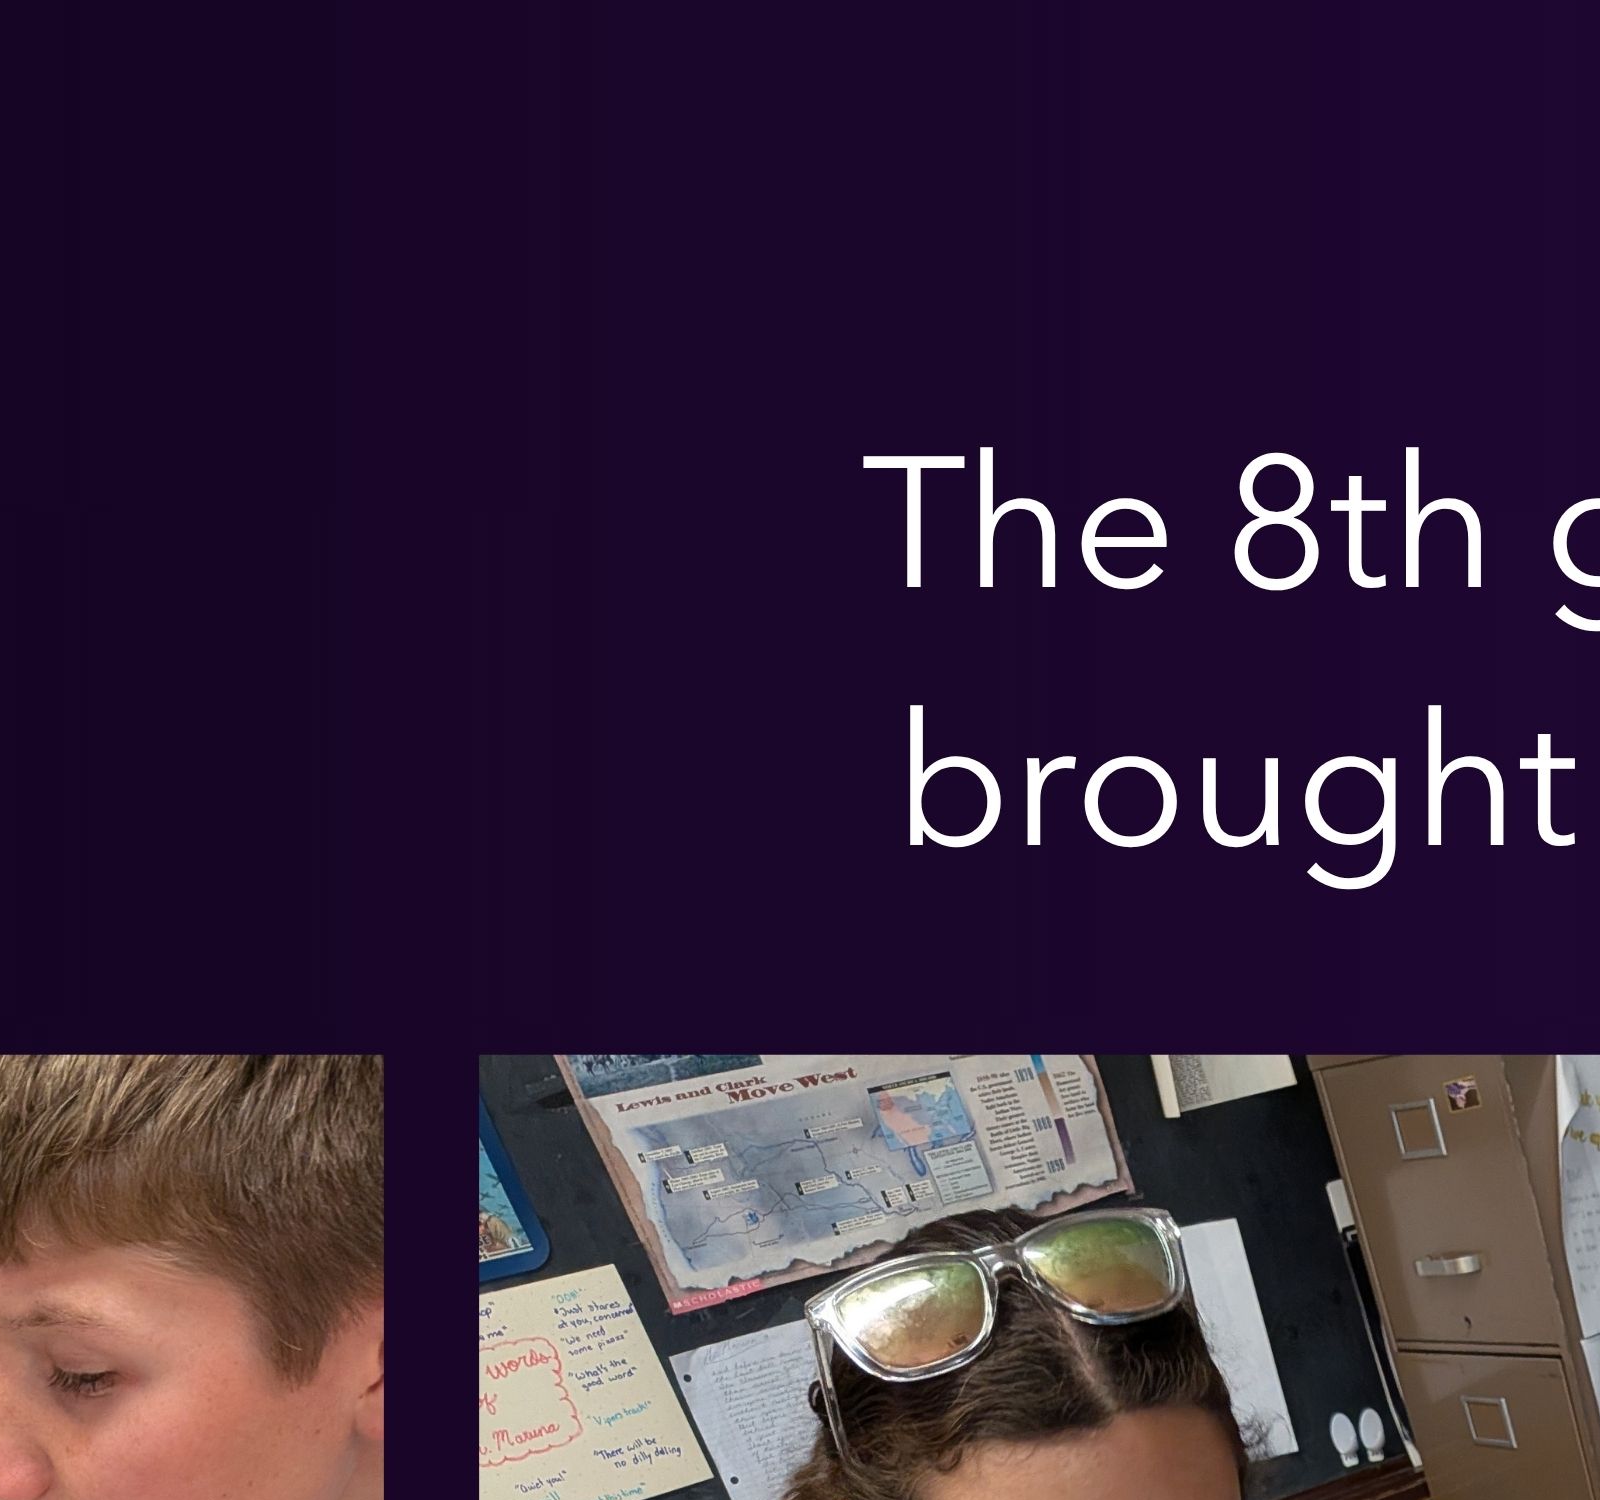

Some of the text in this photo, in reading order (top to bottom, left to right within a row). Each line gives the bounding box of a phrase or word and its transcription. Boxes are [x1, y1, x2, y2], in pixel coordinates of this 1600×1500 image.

[616, 1075, 767, 1112] Lewis and Clark
[727, 1067, 858, 1104] Move West
[609, 1359, 628, 1368] the
[627, 1439, 644, 1451] will
